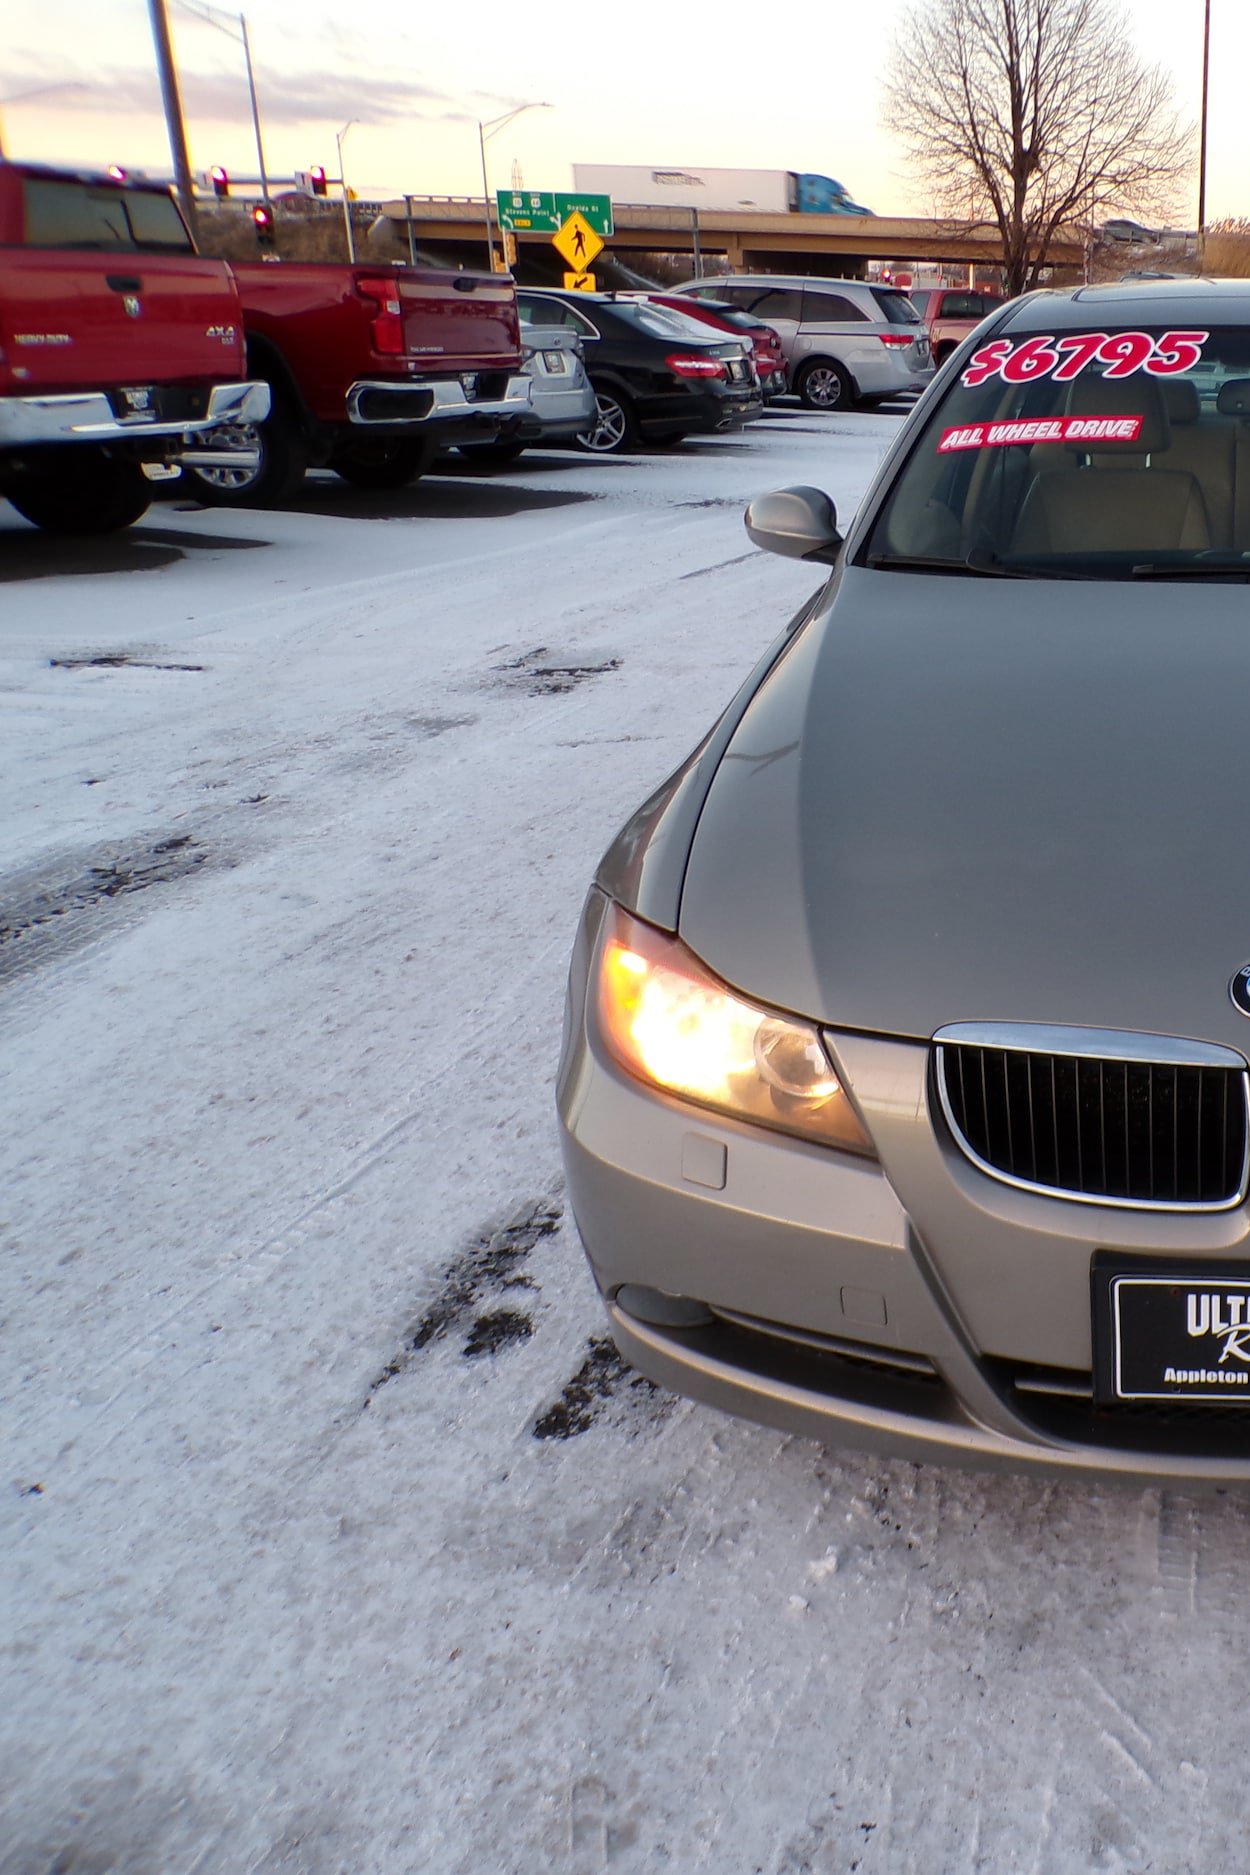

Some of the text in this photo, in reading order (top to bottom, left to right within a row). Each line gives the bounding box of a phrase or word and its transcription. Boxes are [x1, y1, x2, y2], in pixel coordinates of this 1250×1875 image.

[504, 207, 550, 217] Stevens Point
[961, 331, 1209, 388] $6795
[940, 418, 1139, 449] ALL WHEEL DRIVE
[1164, 1367, 1249, 1385] Appleton
